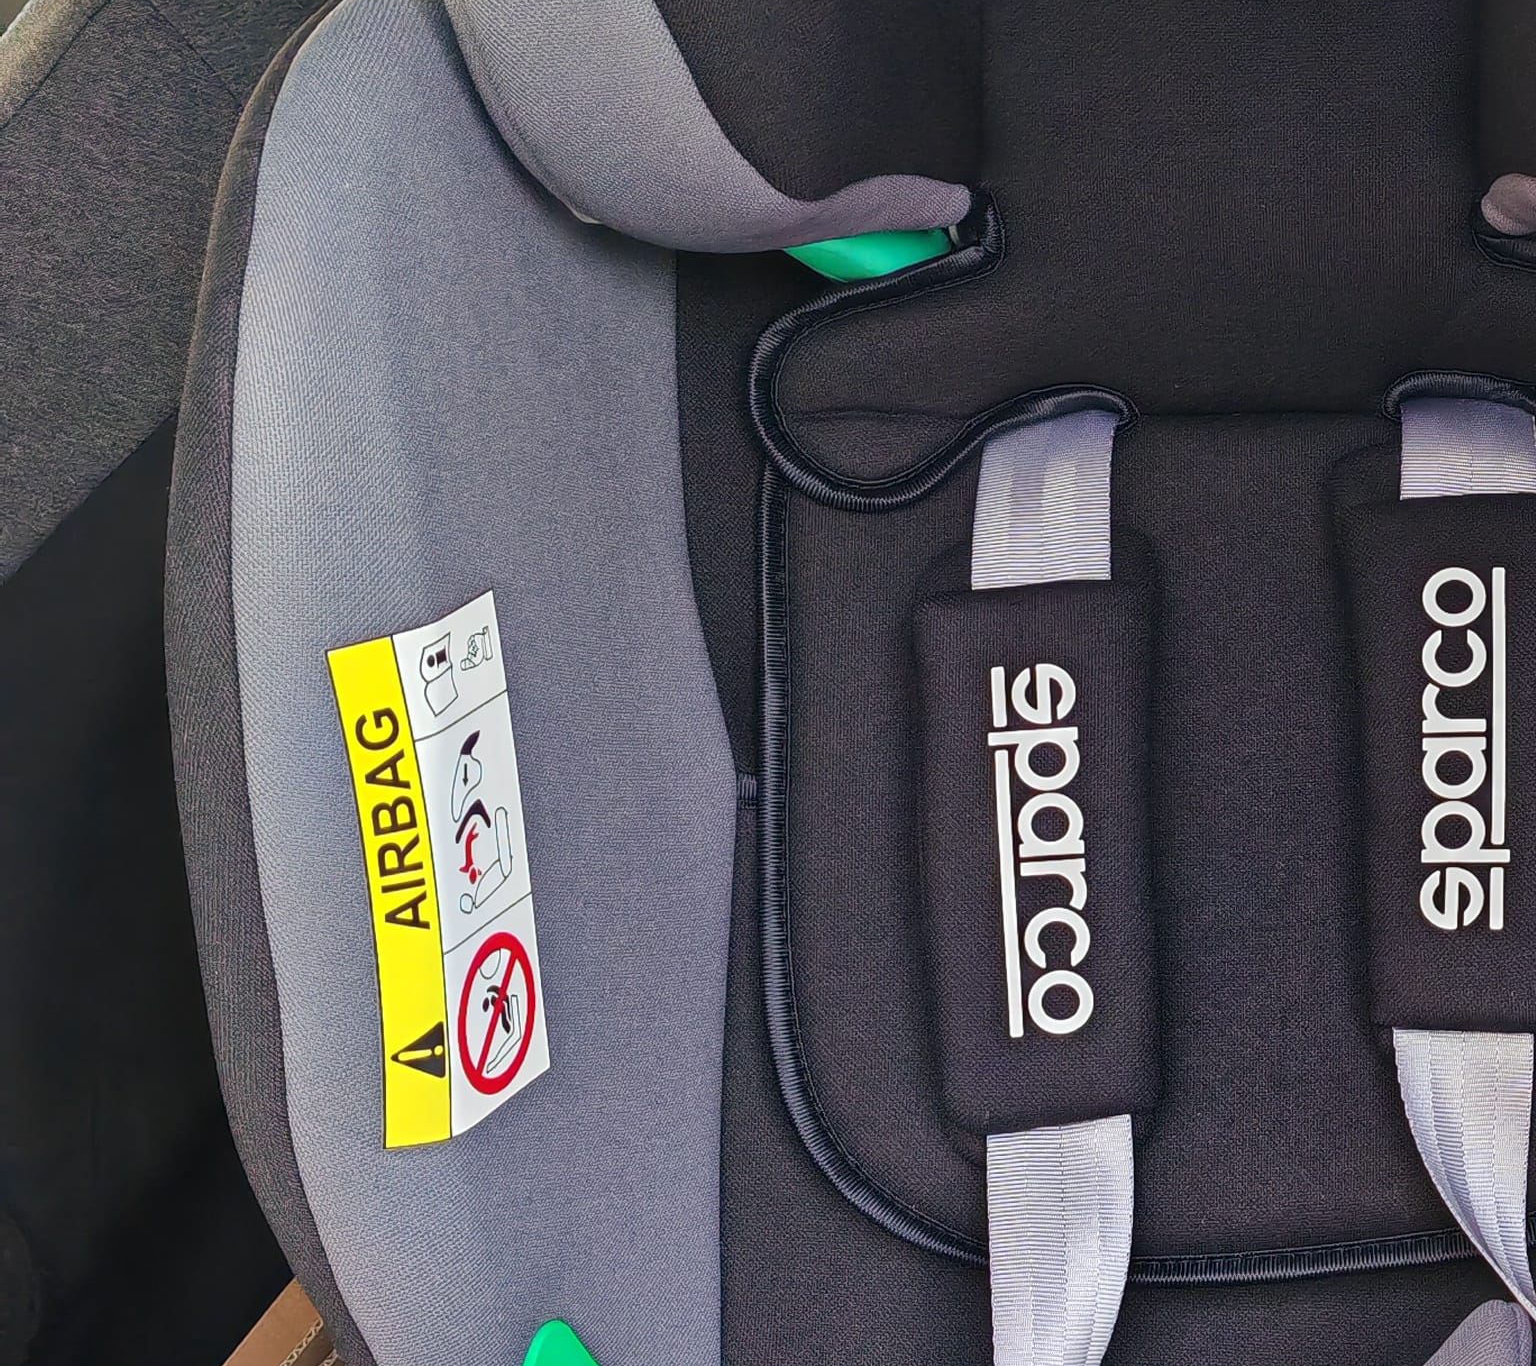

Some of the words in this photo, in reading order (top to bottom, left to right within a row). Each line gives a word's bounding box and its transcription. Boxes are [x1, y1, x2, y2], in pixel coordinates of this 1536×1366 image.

[355, 707, 431, 929] AIRBAG
[988, 663, 1094, 1035] sparco
[1419, 567, 1511, 930] sparco
